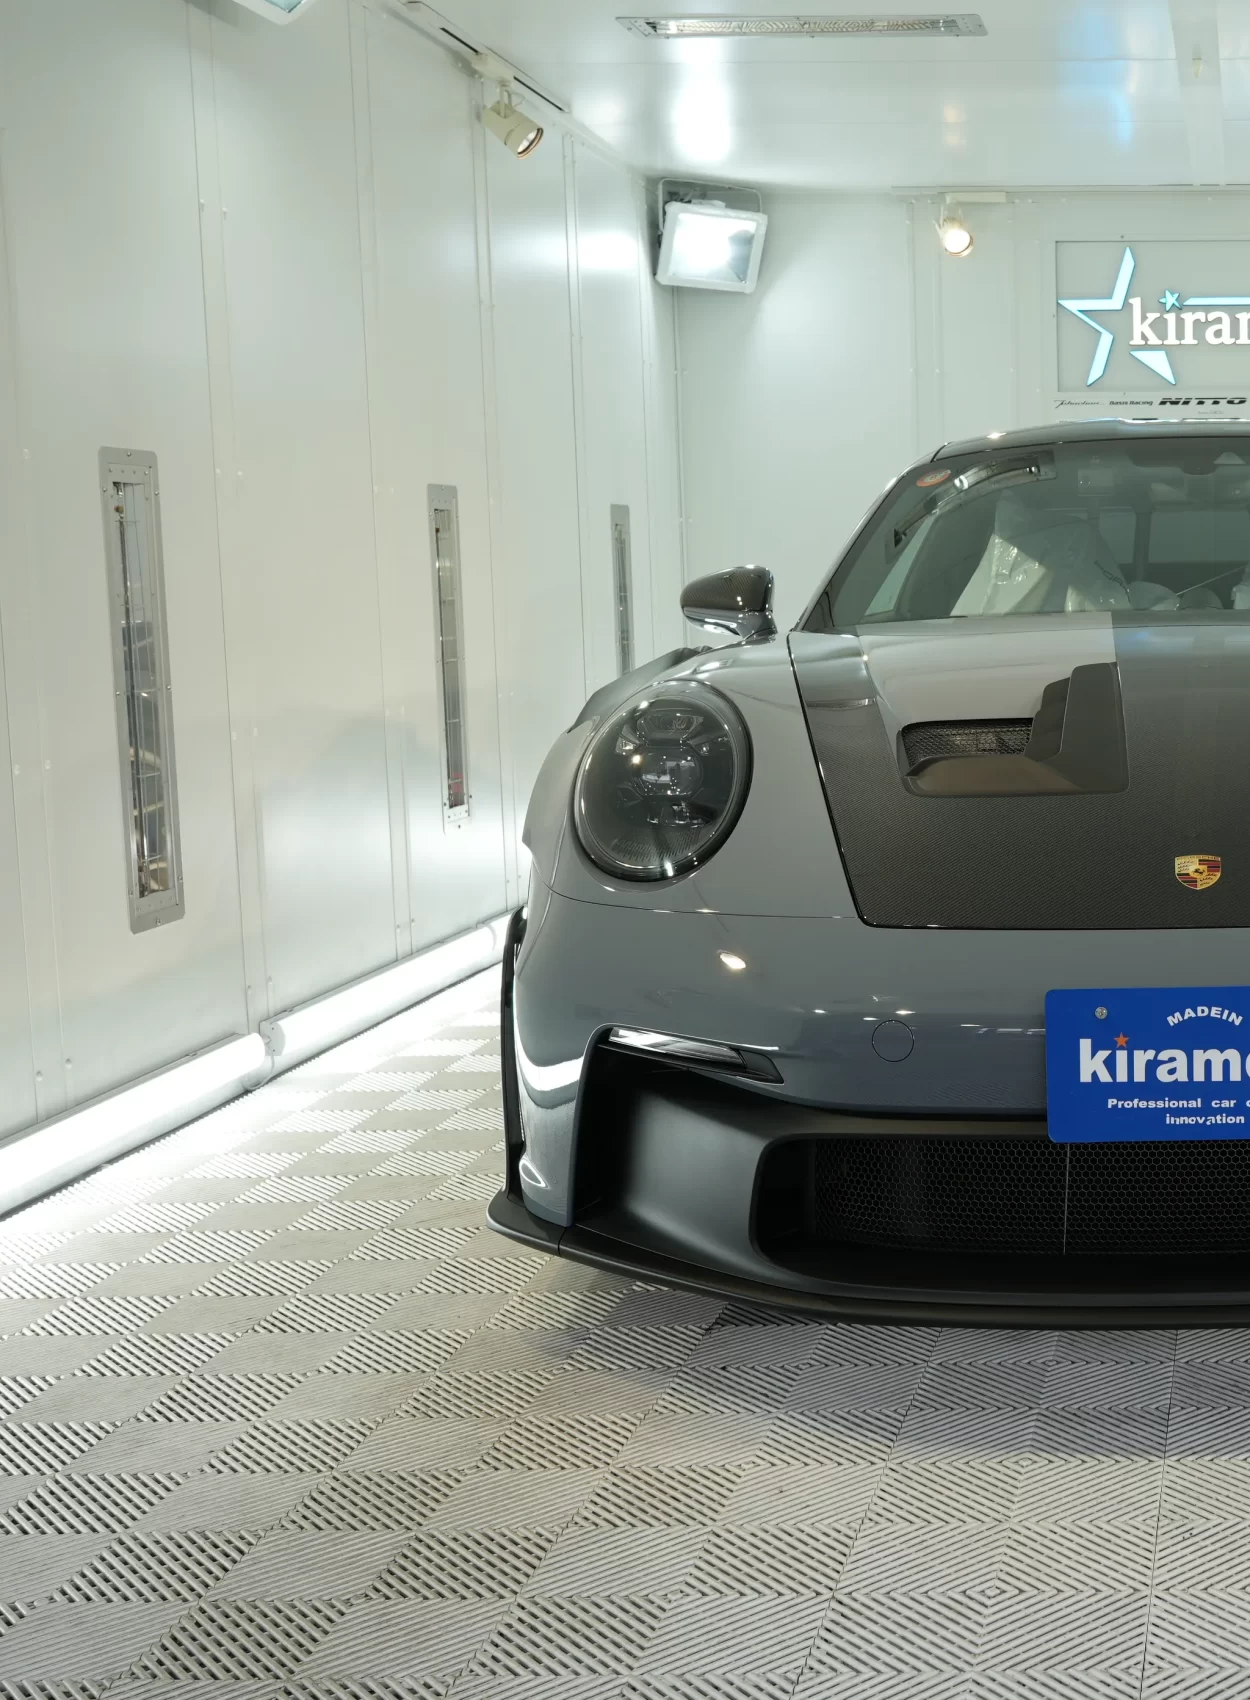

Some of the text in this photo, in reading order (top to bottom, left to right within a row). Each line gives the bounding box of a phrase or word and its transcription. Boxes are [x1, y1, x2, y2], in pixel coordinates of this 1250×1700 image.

[1158, 397, 1247, 406] NITTO
[1166, 1005, 1244, 1027] MADEIN
[1107, 1097, 1202, 1109] Professional
[1211, 1099, 1237, 1108] car
